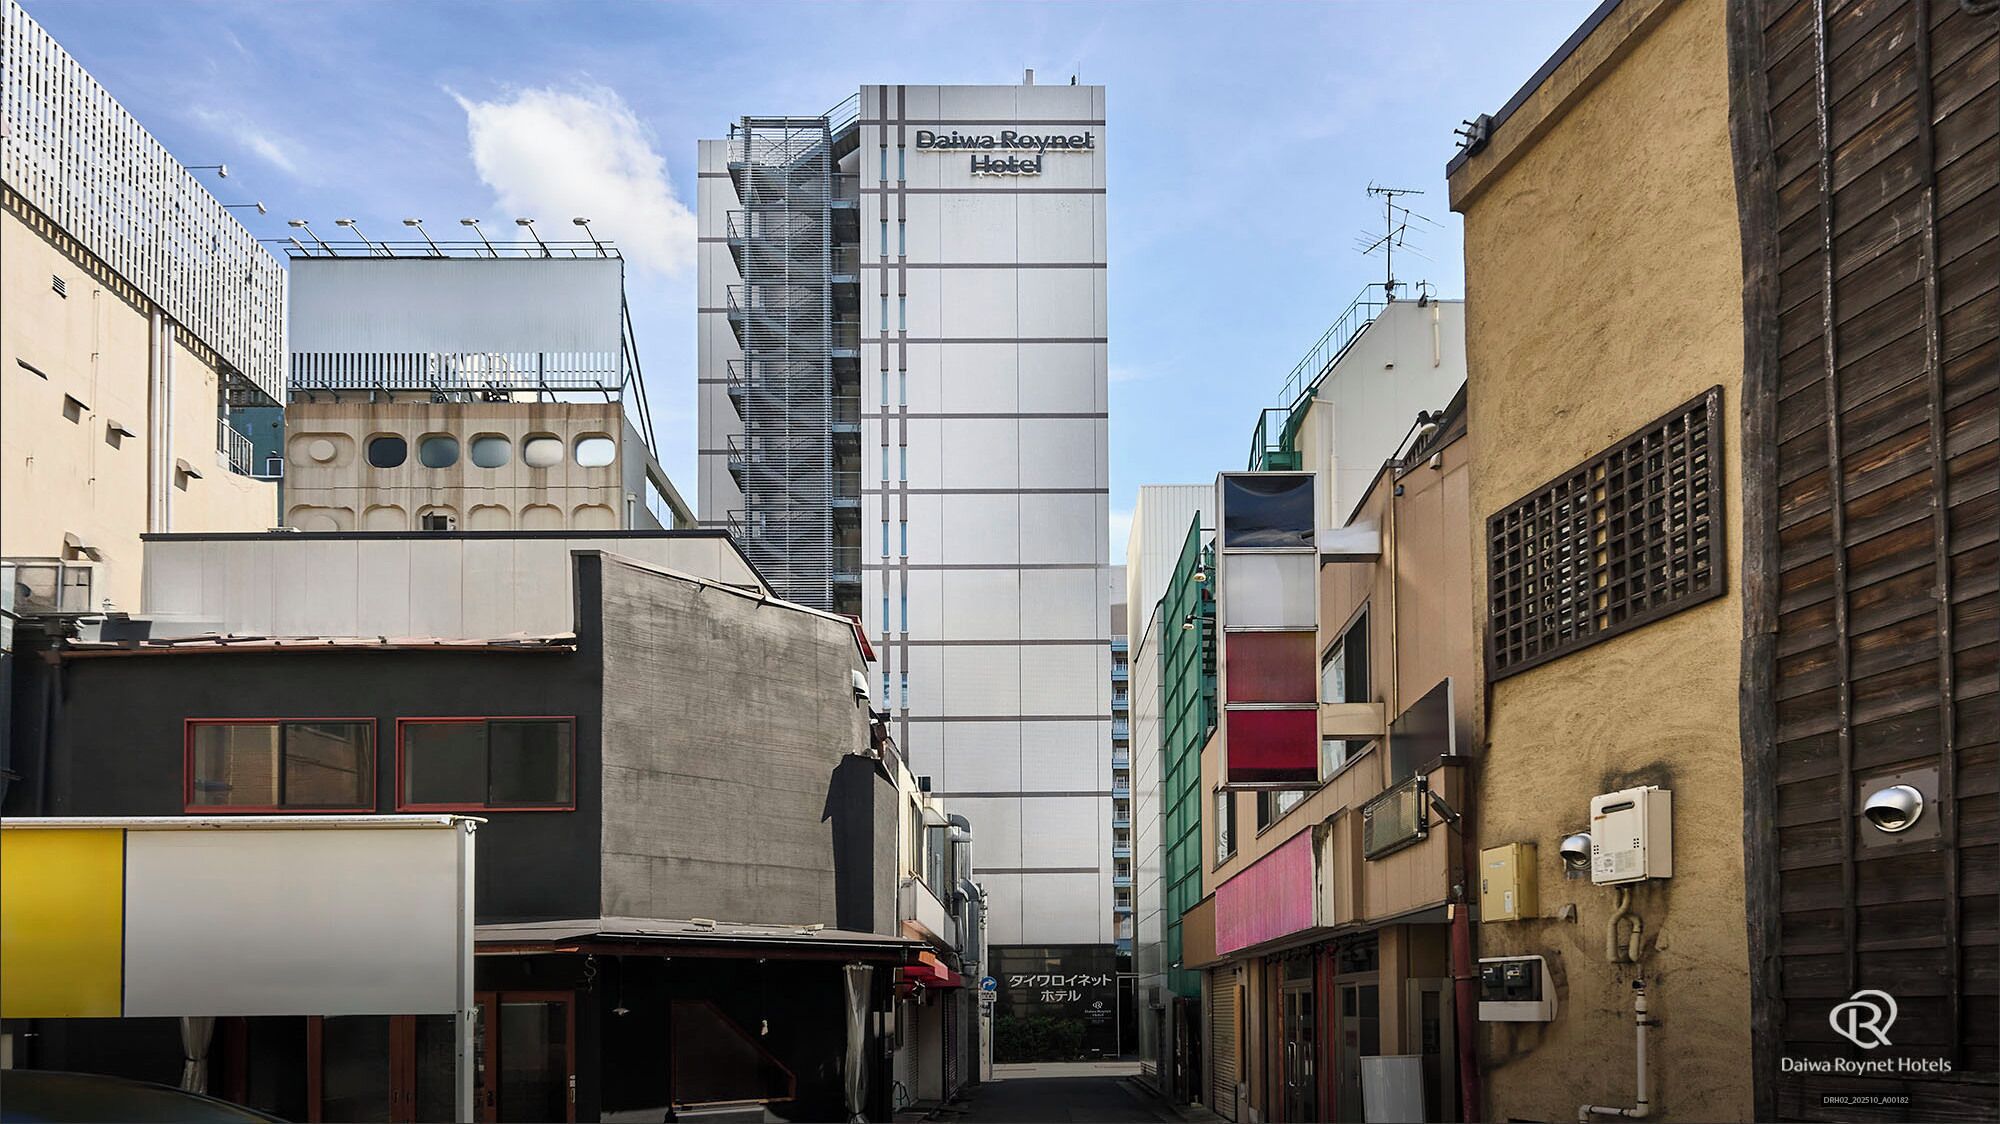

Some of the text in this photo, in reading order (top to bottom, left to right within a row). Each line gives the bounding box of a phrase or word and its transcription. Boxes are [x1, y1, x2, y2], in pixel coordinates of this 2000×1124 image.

[916, 130, 1095, 154] Daiwa Roynet
[971, 155, 1041, 173] Hotel
[1009, 974, 1112, 988] ダイワロイネット
[1040, 989, 1081, 1002] ホテル
